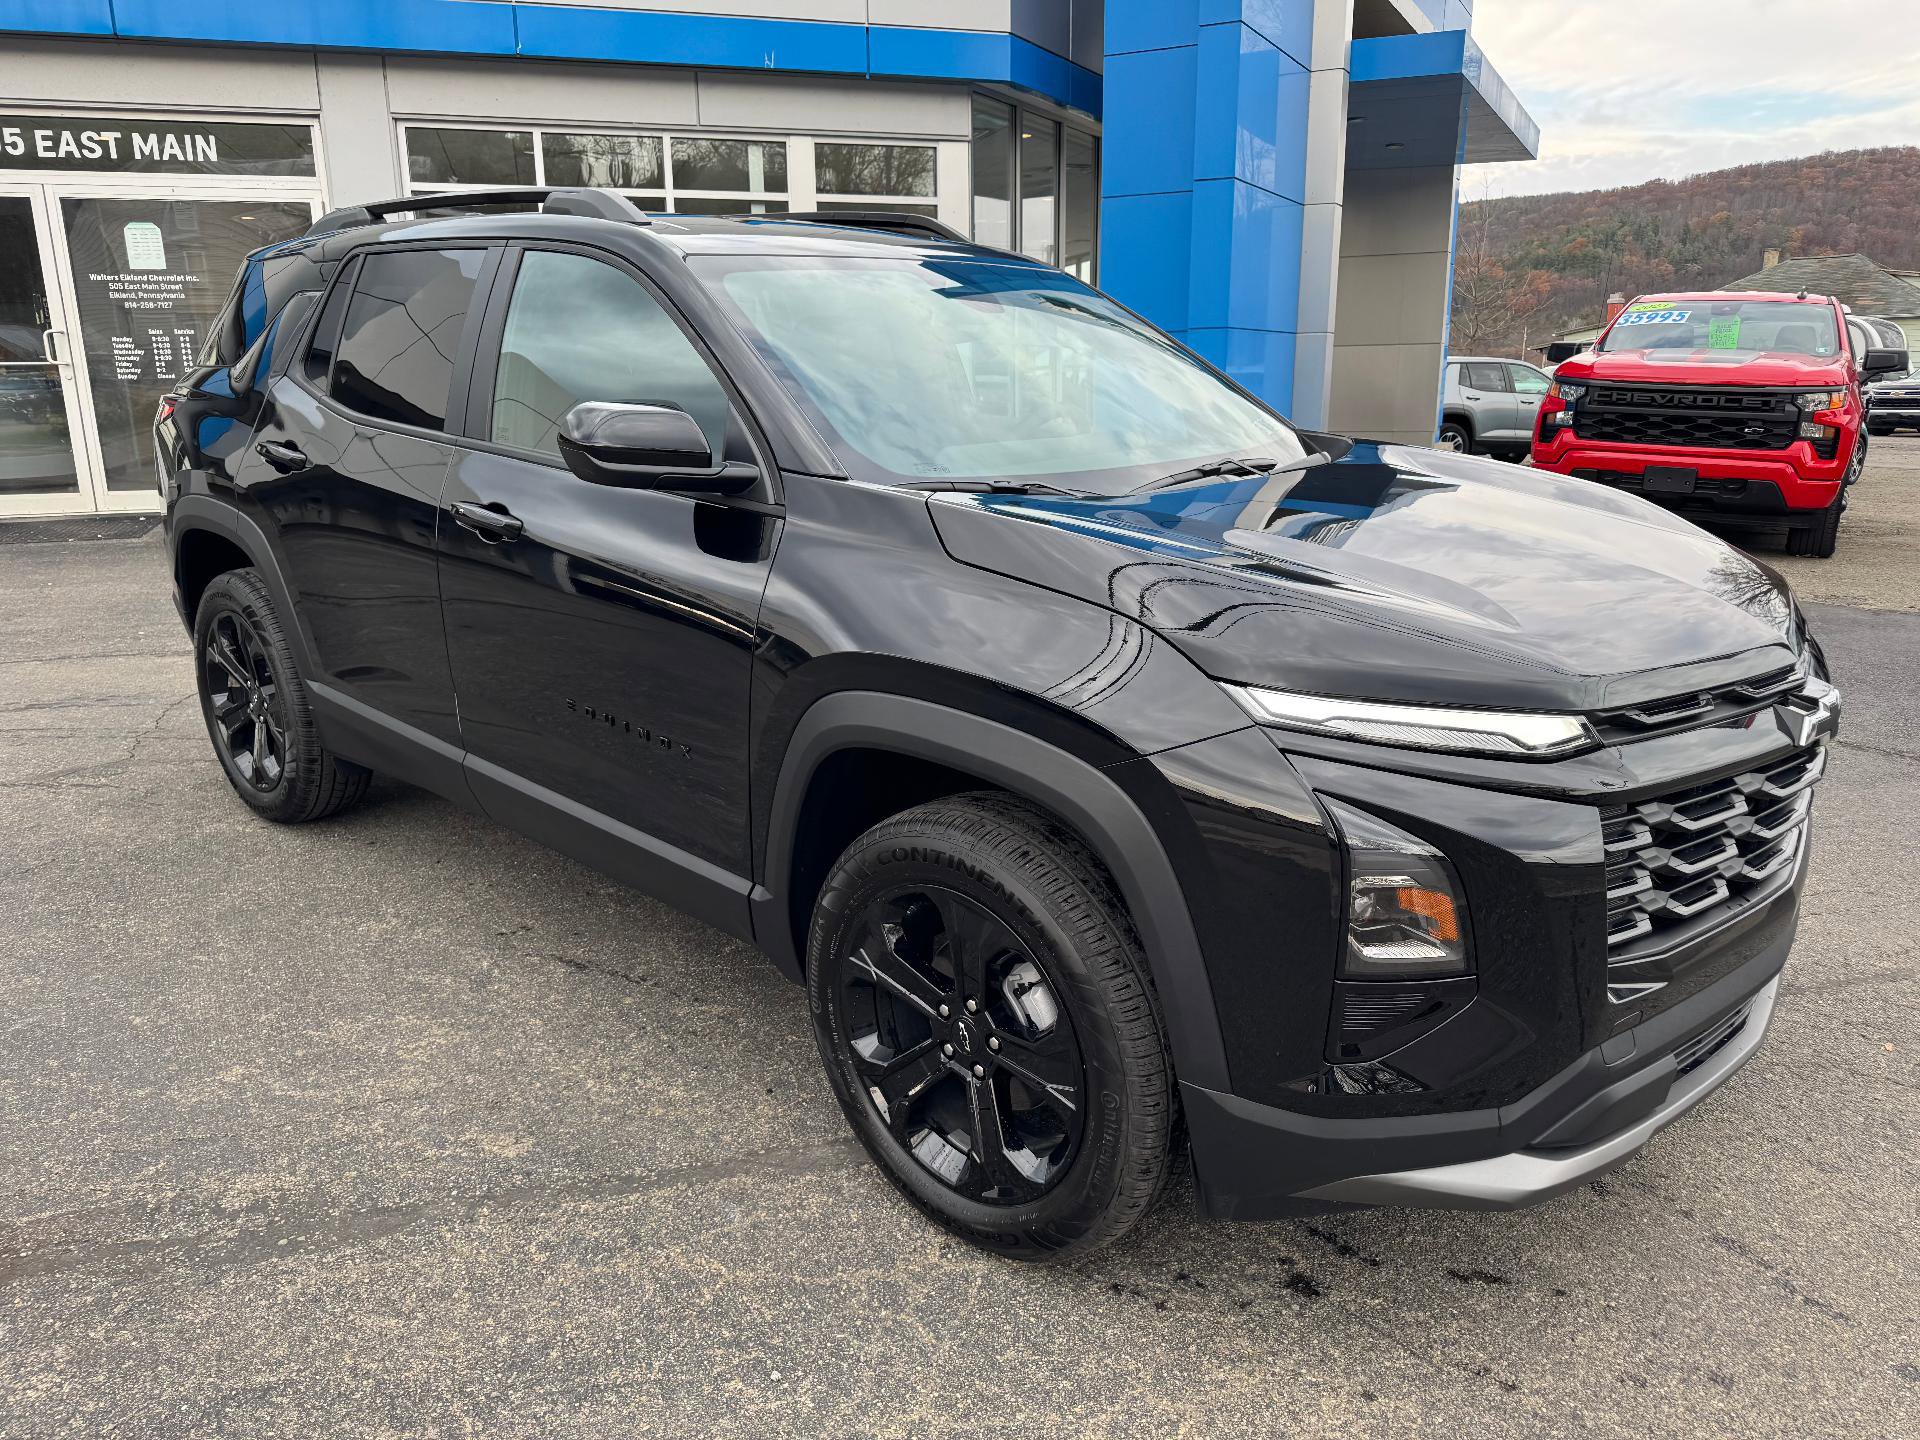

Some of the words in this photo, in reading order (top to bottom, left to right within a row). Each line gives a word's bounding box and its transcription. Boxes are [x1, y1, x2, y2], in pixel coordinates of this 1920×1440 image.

[0, 127, 25, 156] 5
[33, 129, 122, 159] EAST
[132, 132, 218, 162] MAIN
[89, 273, 119, 282] Walters
[120, 274, 148, 282] Elkland
[149, 274, 185, 282] Chevrolet
[108, 282, 124, 290] 505
[109, 291, 138, 299] Elkland,
[138, 291, 186, 300] Pennsylvania
[124, 301, 173, 309] 814-258-7127
[1617, 311, 1689, 325] 35995
[1592, 390, 1786, 409] CHEVROLET
